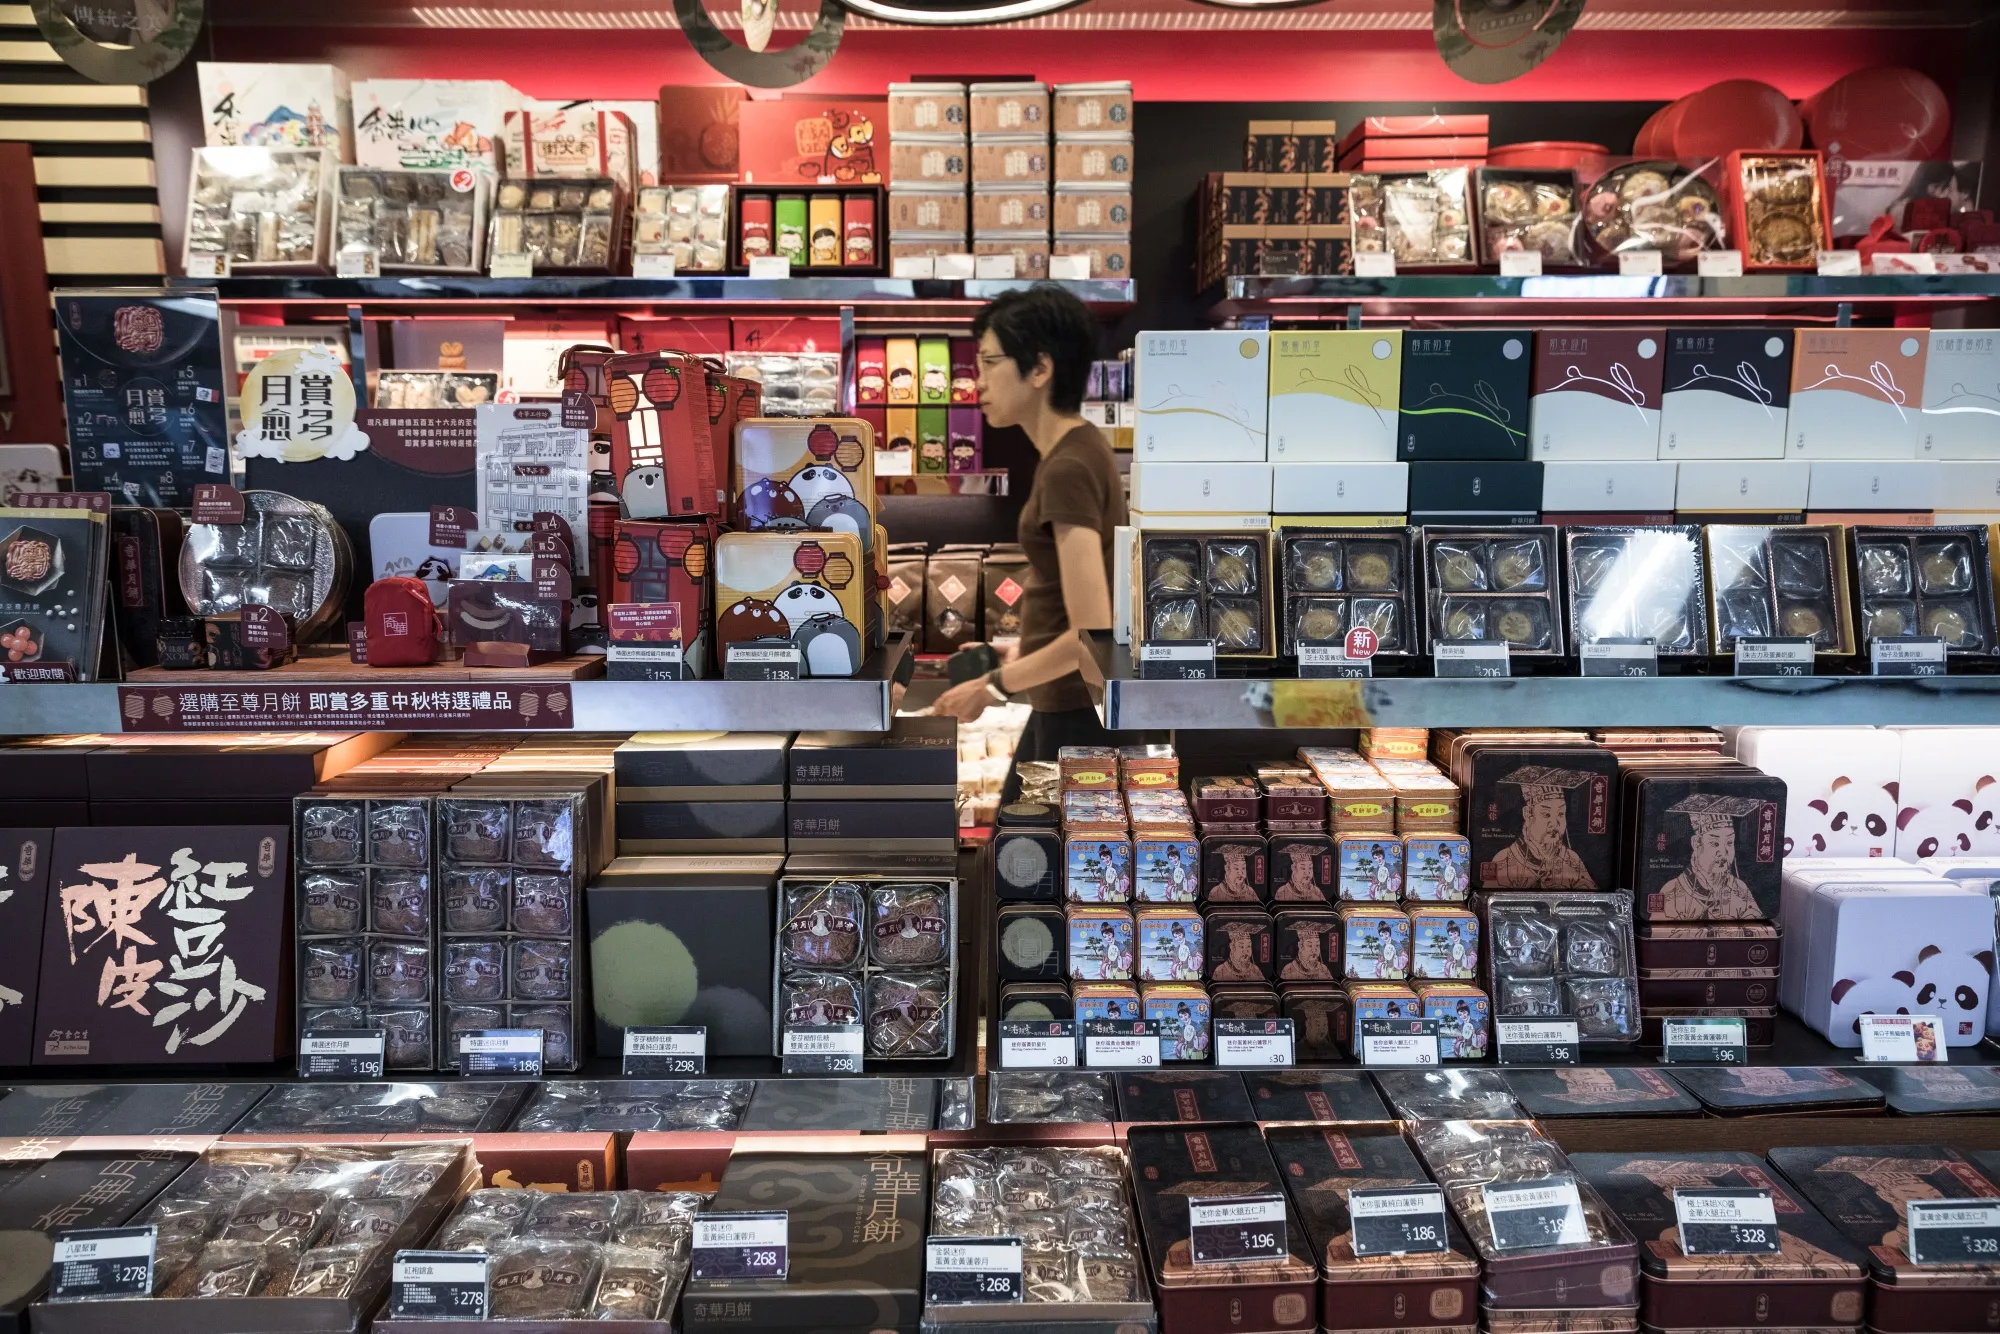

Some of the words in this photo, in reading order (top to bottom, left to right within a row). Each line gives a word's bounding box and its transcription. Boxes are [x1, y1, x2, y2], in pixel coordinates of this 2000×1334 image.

[260, 374, 333, 407] 月賞
[260, 408, 333, 442] 愈多
[1353, 630, 1371, 649] 新
[1352, 648, 1371, 656] New
[14, 669, 65, 680] 歡迎取閱
[179, 692, 301, 712] 選購至尊月餅
[309, 691, 512, 711] 即賞多重中秋特選禮品
[796, 765, 844, 778] 奇華月餅
[1591, 781, 1605, 828] 奇華月餅
[793, 818, 840, 831] 奇華月餅
[1759, 809, 1774, 856] 奇華月餅
[60, 852, 168, 1016] 陳皮
[153, 847, 266, 1055] 紅豆沙
[1137, 1055, 1153, 1065] $30
[1269, 1054, 1284, 1063] $30
[1415, 1054, 1431, 1063] $30
[1550, 1048, 1569, 1059] $96
[1715, 1050, 1734, 1061] $96
[353, 1061, 379, 1073] $196
[512, 1060, 539, 1071] $186
[669, 1060, 695, 1072] $298
[827, 1058, 854, 1070] $298
[1052, 1056, 1068, 1066] $30
[862, 1150, 921, 1244] 奇華月餅
[1199, 1207, 1266, 1219] 迷你金華火腿五仁月
[1687, 1209, 1742, 1218] 金華火腿五仁月
[702, 1222, 733, 1231] 金裝迷你
[1543, 1218, 1573, 1235] $18
[702, 1231, 756, 1241] 蛋黃純白蓮蓉月
[1405, 1225, 1436, 1242] $186
[1735, 1228, 1766, 1245] $328
[1244, 1233, 1275, 1250] $196
[1967, 1238, 1998, 1254] $328
[935, 1247, 967, 1256] 金裝迷你
[746, 1251, 777, 1267] $268
[935, 1257, 989, 1266] 蛋黃金黃蓮蓉月
[115, 1266, 147, 1283] $278
[980, 1277, 1011, 1293] $268
[454, 1291, 484, 1306] $278
[694, 1302, 752, 1317] 奇華月餅
